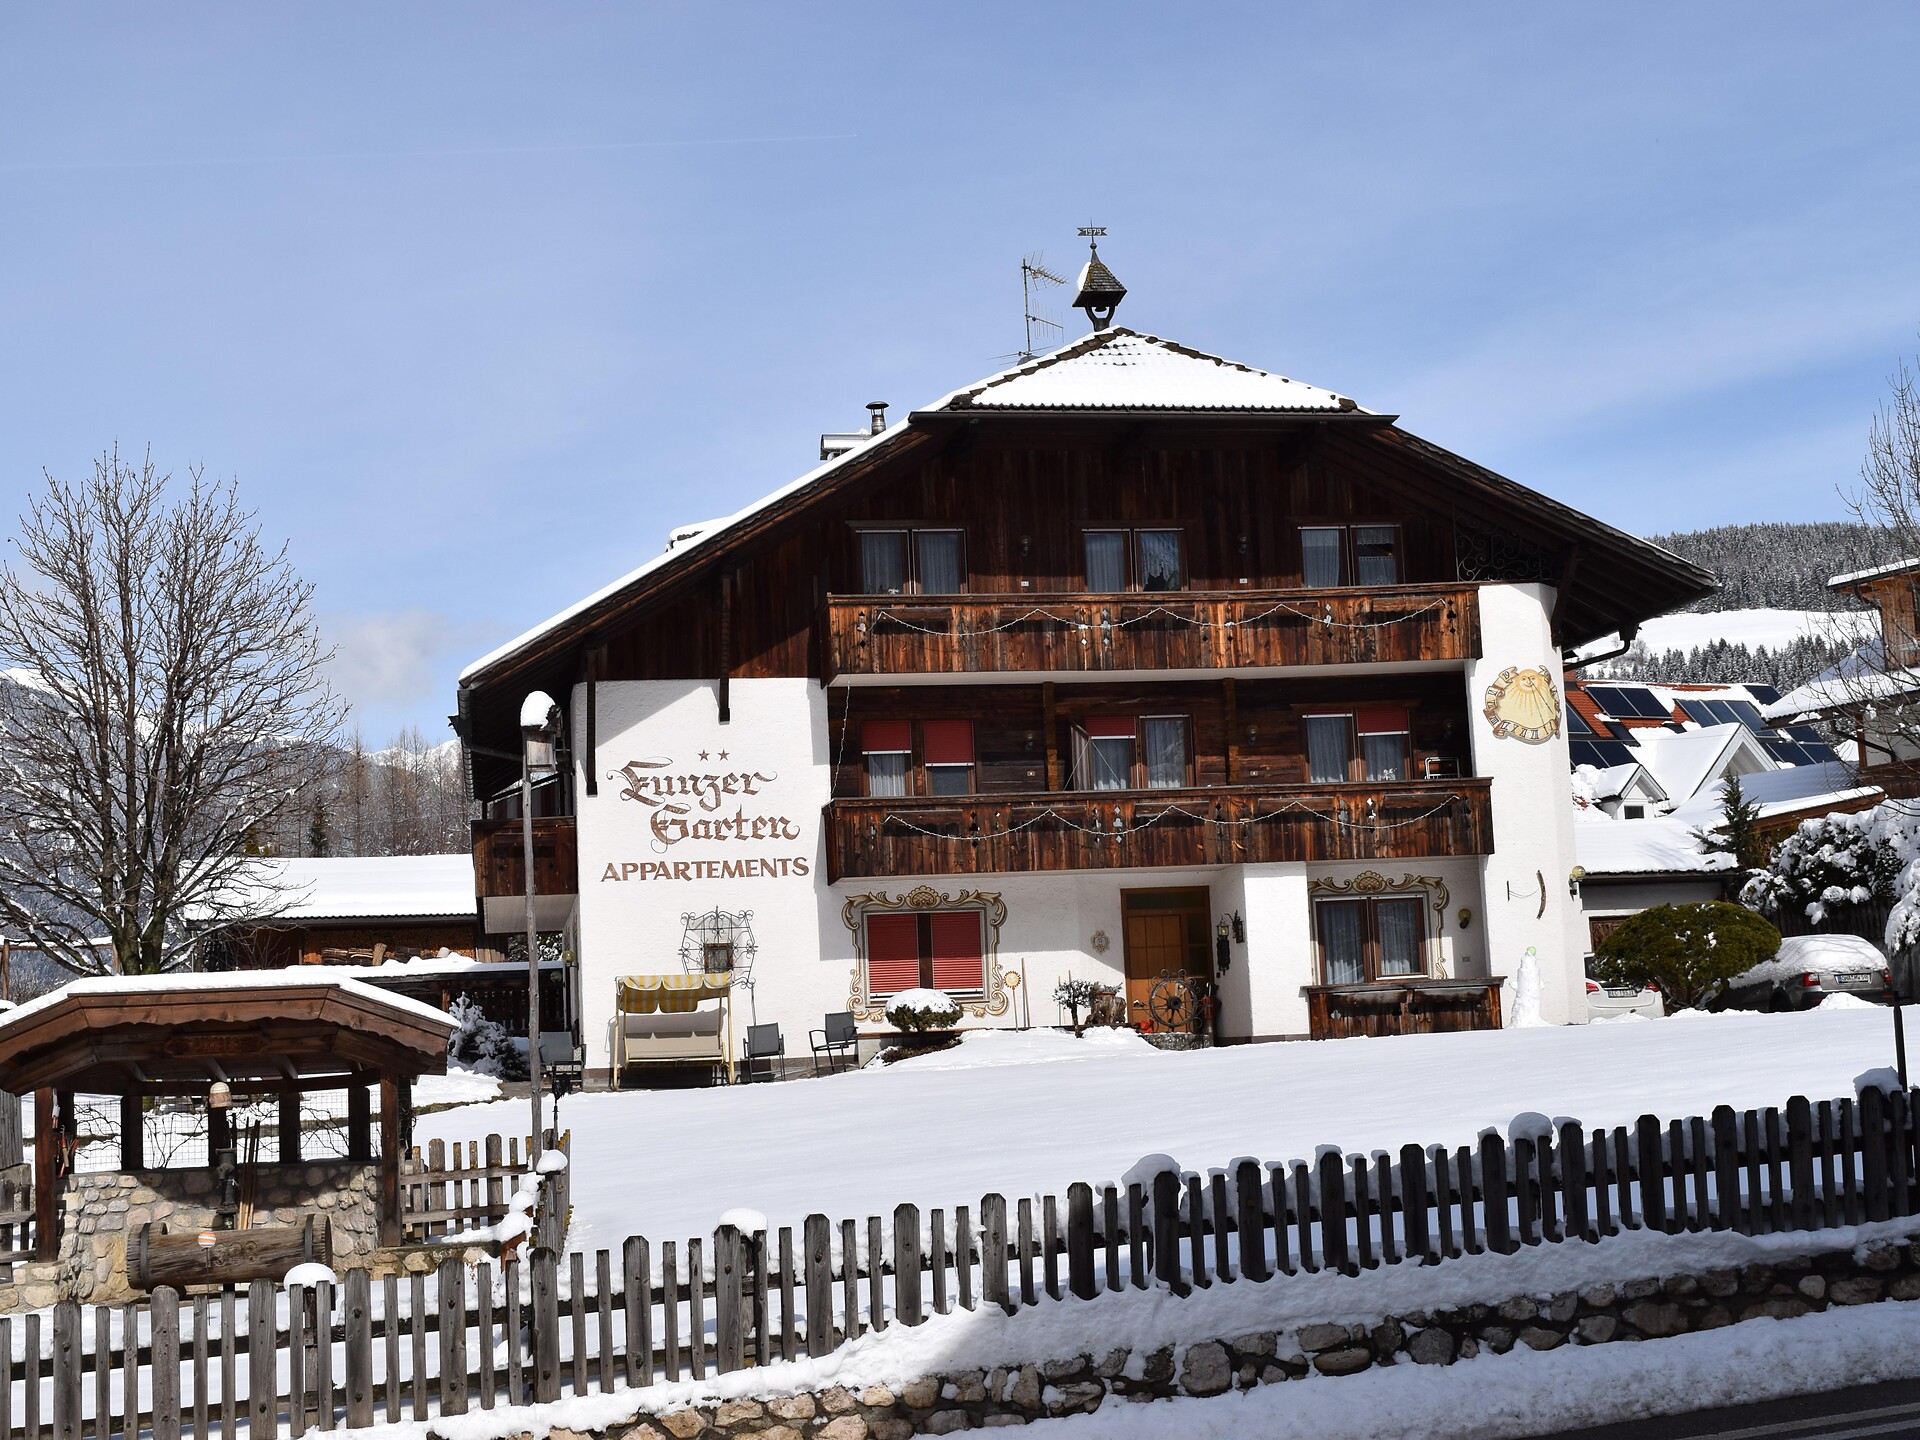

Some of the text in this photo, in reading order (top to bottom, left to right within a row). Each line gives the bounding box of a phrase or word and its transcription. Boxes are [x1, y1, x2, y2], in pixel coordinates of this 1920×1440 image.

[1083, 228, 1102, 236] 1979
[650, 803, 800, 854] Garten
[600, 856, 810, 882] APPARTEMENTS
